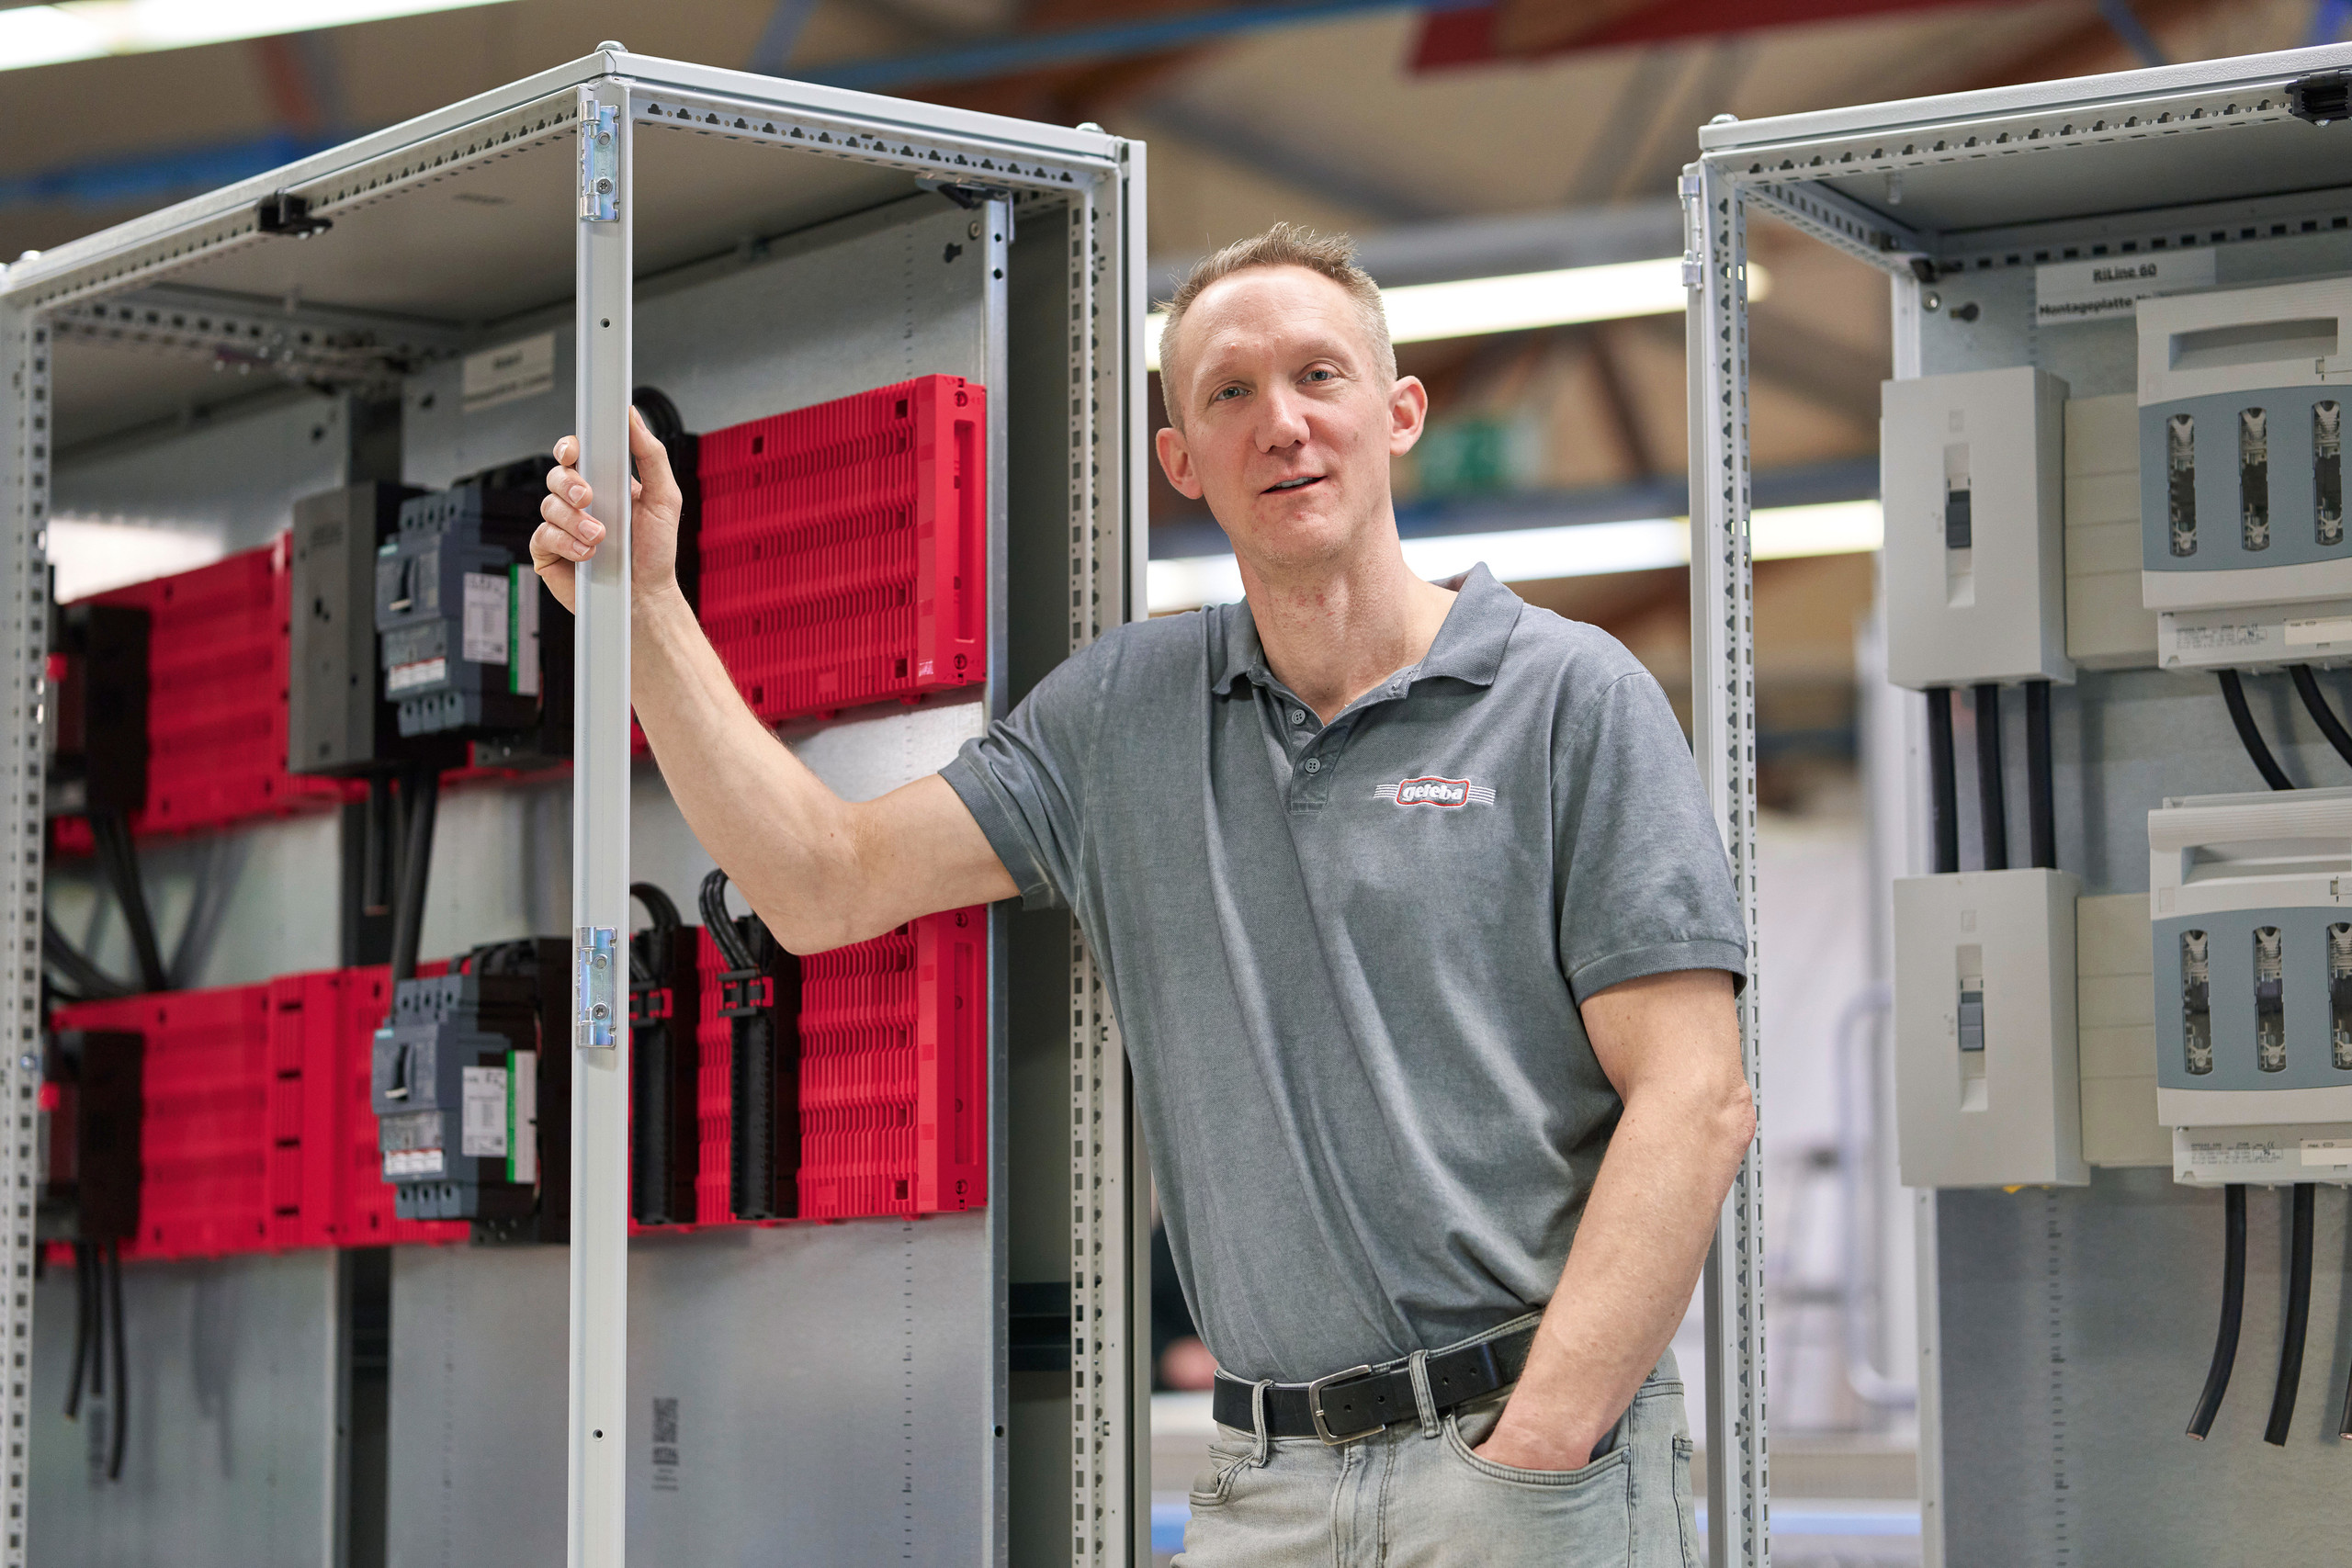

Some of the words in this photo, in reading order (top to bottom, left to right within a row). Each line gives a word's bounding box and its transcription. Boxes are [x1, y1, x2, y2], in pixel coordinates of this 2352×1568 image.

[2093, 266, 2135, 282] RiLine
[2140, 263, 2157, 276] 60
[2039, 297, 2133, 315] Montageplatte
[1402, 784, 1464, 801] gefeba
